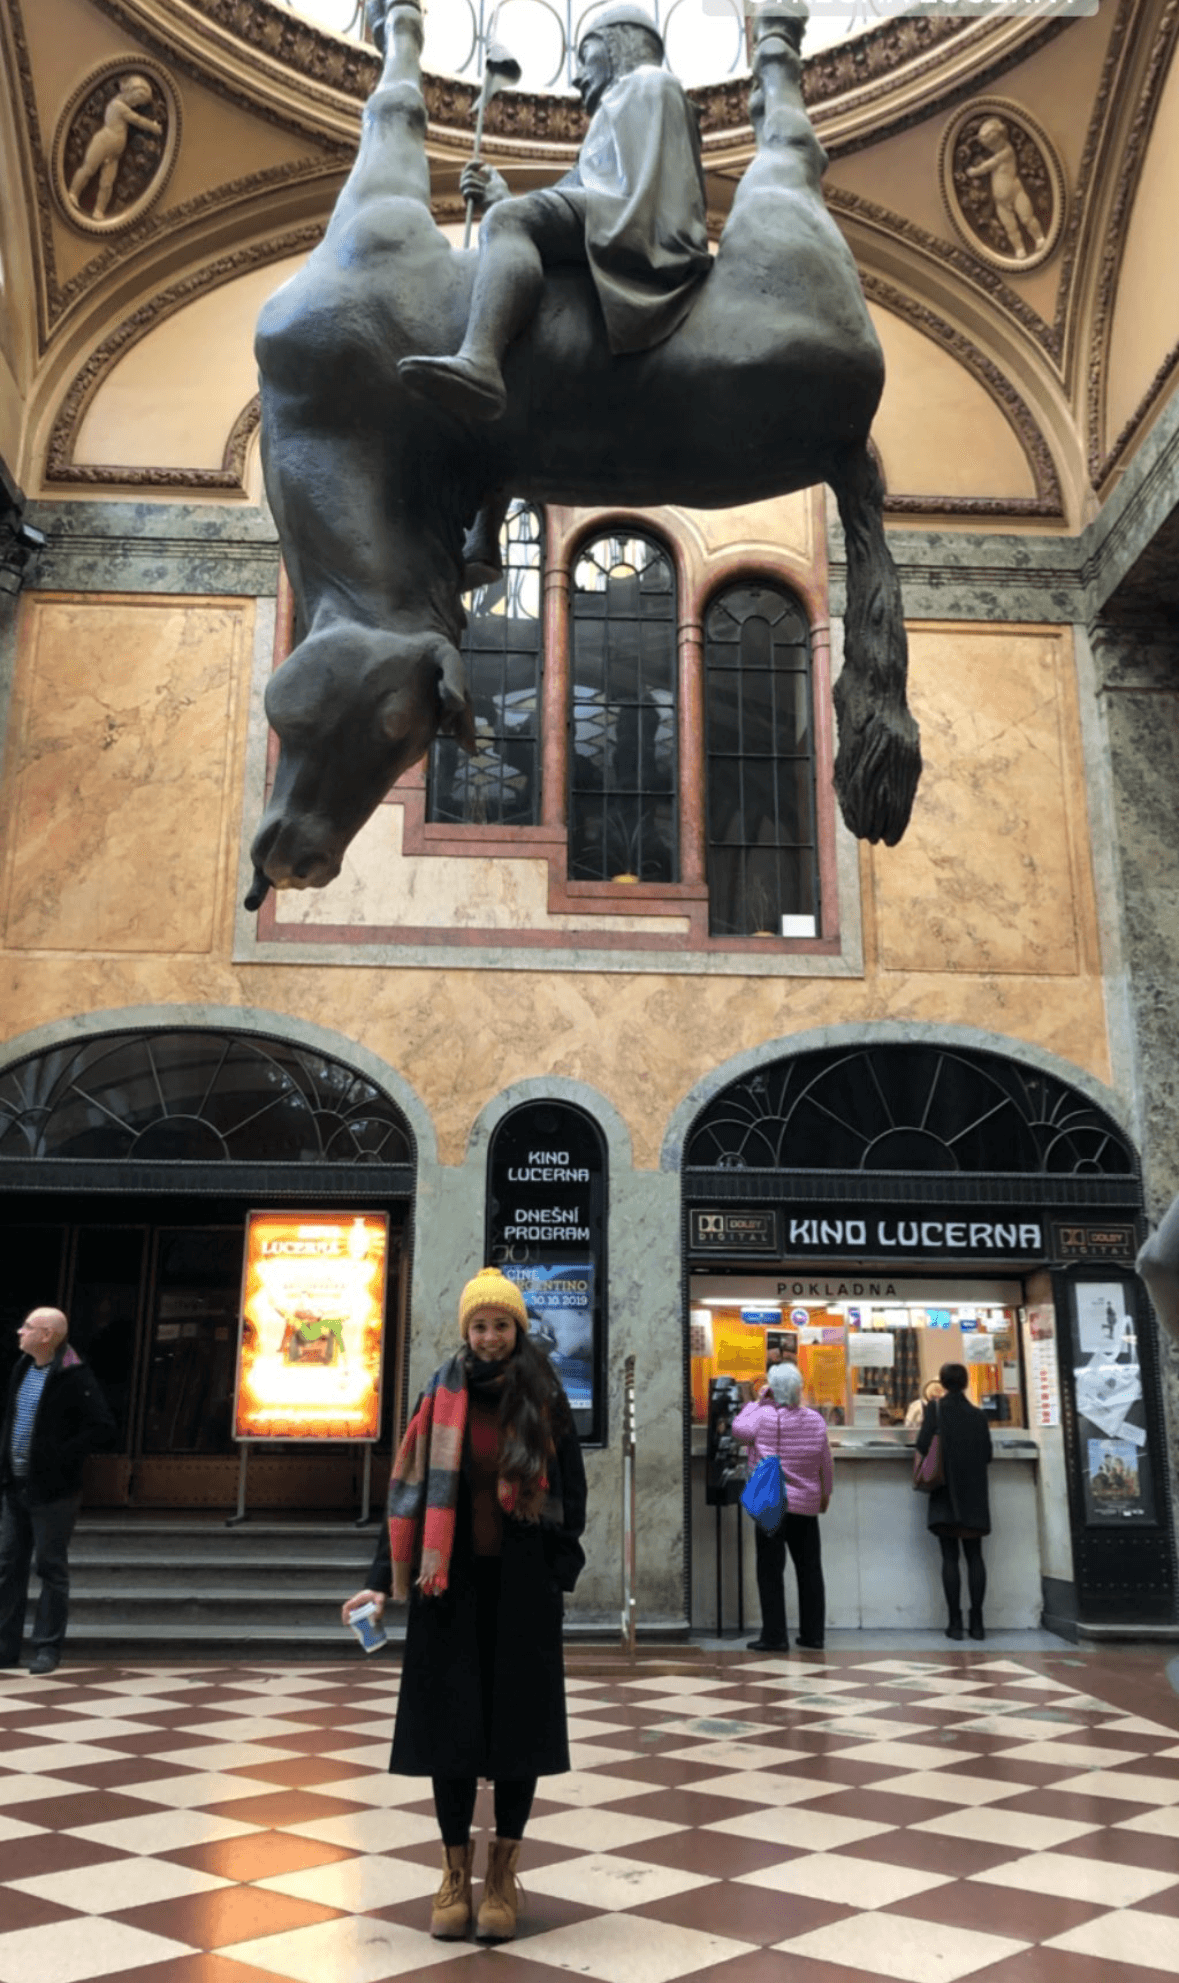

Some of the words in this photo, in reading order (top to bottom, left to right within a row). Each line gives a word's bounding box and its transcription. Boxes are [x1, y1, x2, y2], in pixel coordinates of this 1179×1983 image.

[528, 1150, 570, 1165] KINO
[507, 1167, 590, 1182] LUCERNA
[514, 1206, 580, 1224] DNEŠNÍ
[729, 1219, 762, 1229] DOLBY
[503, 1225, 591, 1241] PROGRAM
[698, 1232, 768, 1242] DIGITAL
[788, 1219, 867, 1245] KINO
[877, 1221, 1042, 1249] LUCERNA
[506, 1269, 540, 1281] CINE
[514, 1280, 588, 1292] RGENTINO
[776, 1281, 898, 1298] POKLADNA
